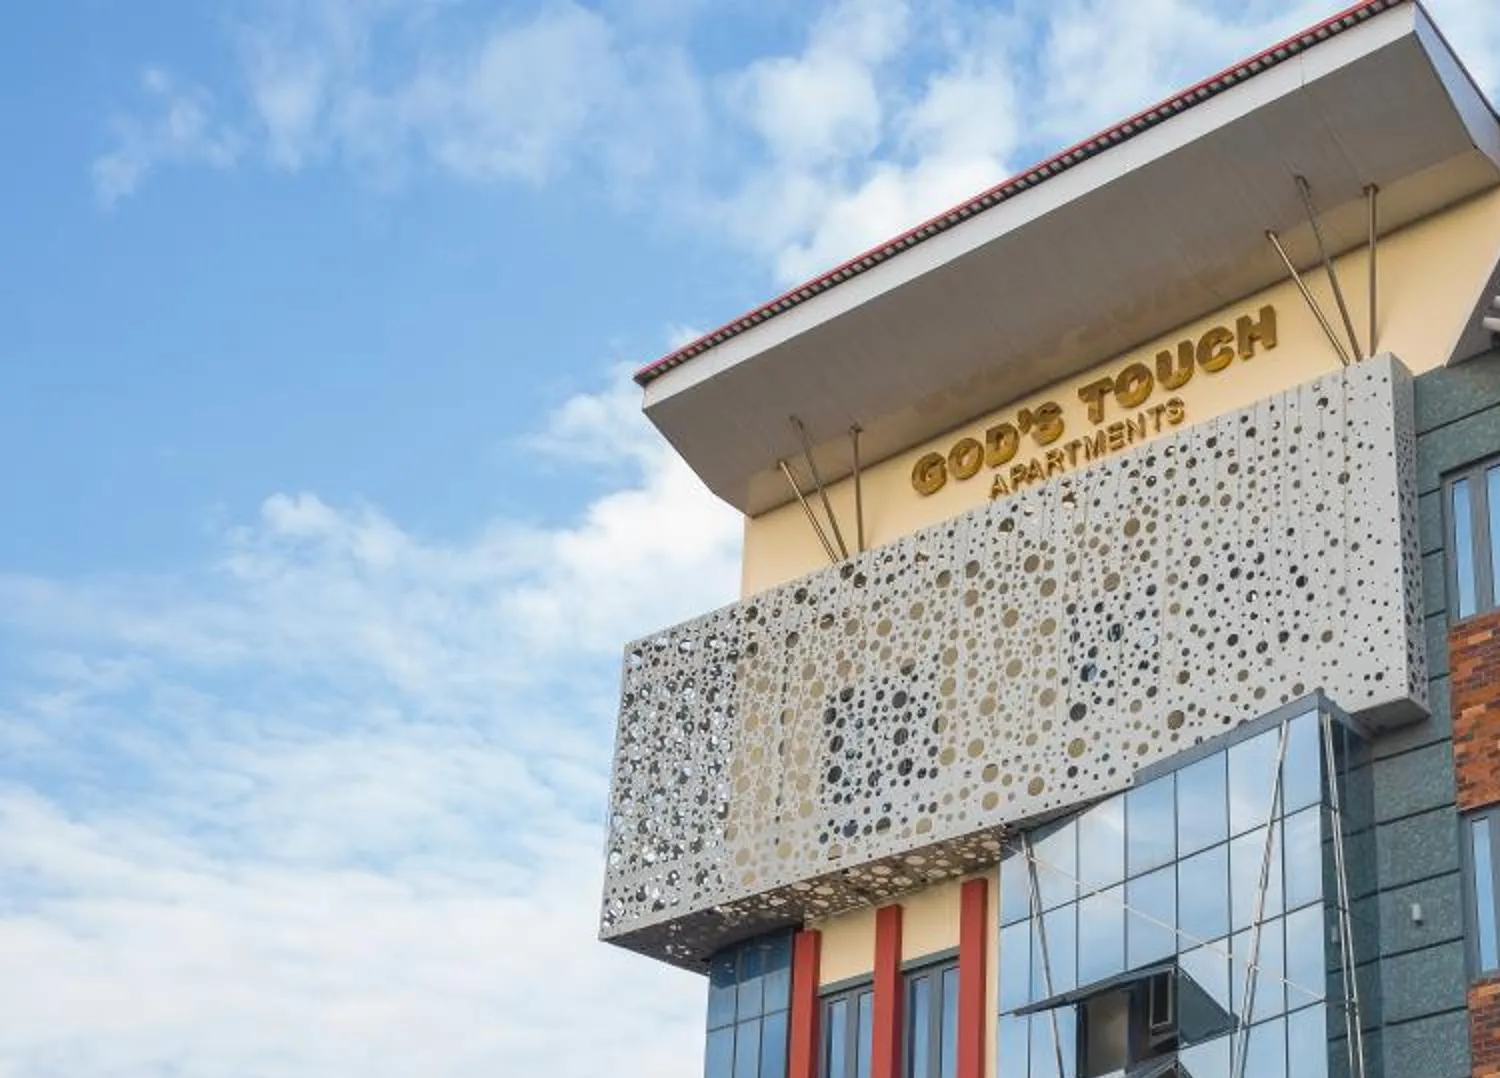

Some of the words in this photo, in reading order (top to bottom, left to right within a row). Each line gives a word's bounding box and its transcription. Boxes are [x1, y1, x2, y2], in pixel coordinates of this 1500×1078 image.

[911, 401, 1066, 497] GOD'S
[1078, 304, 1279, 425] TOUCH
[989, 397, 1186, 499] APARTMENTS
